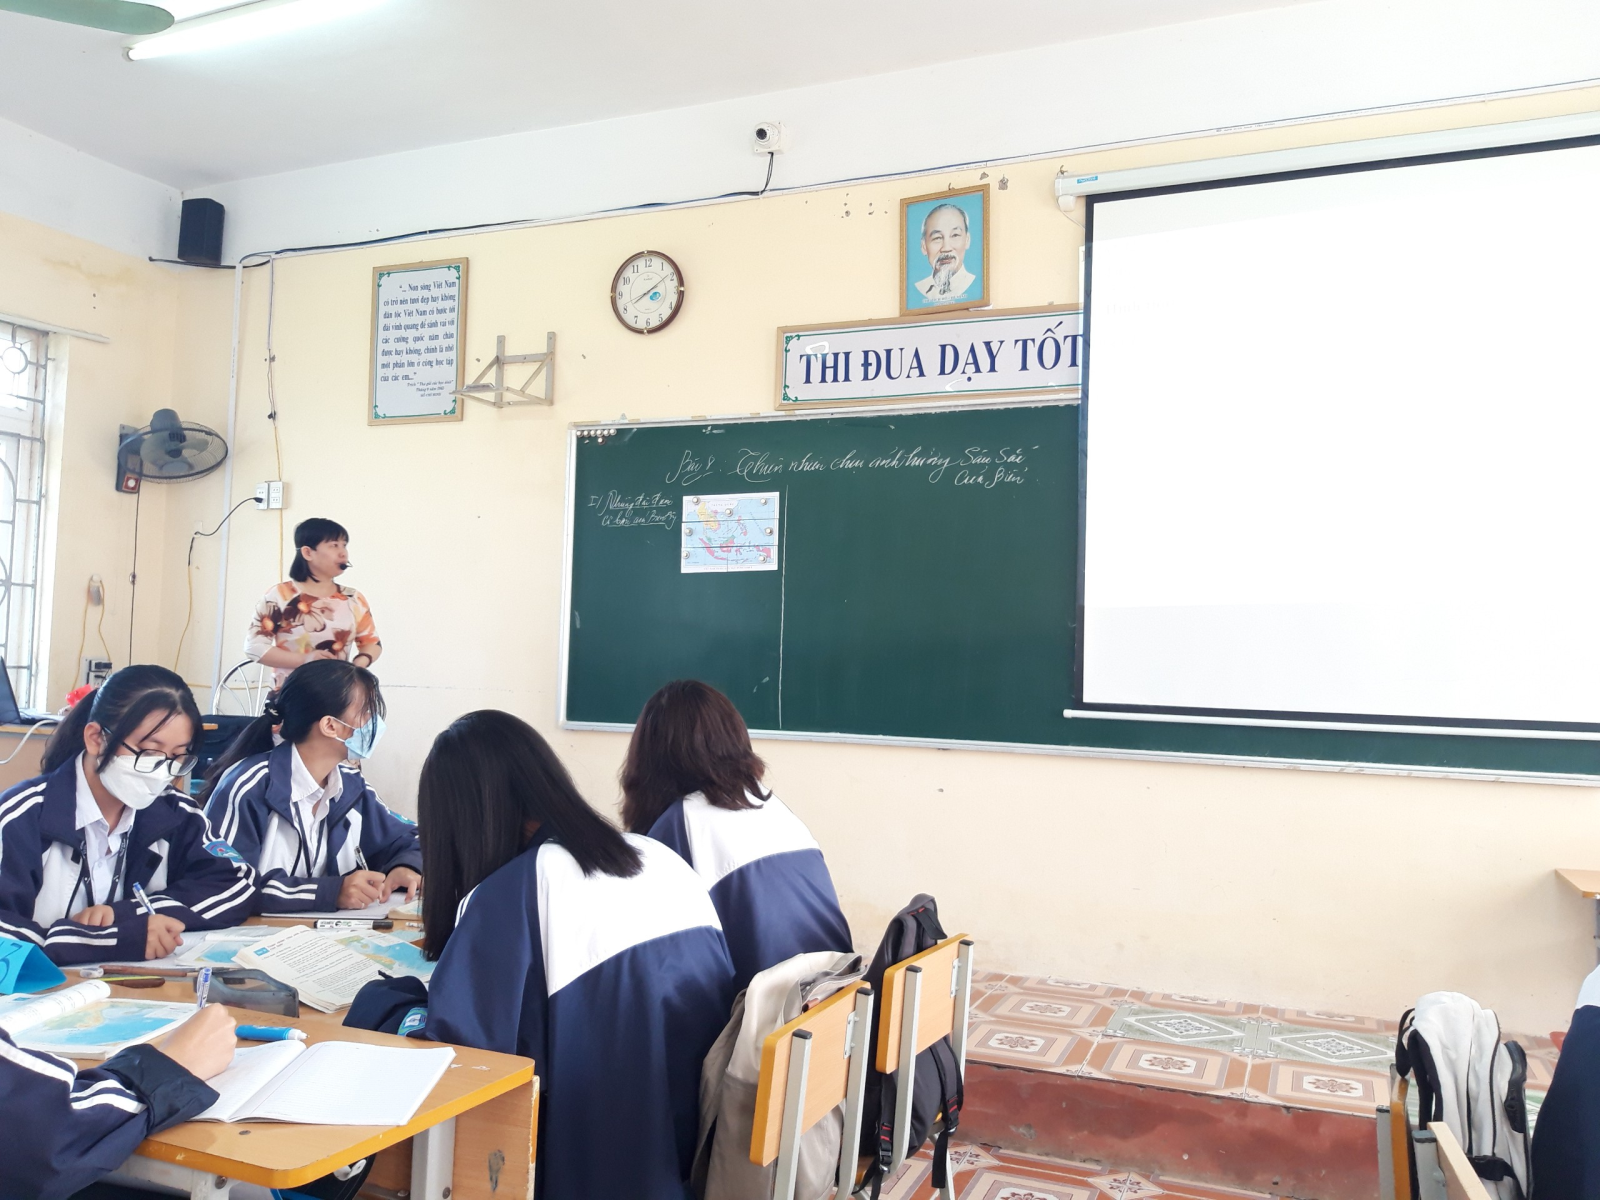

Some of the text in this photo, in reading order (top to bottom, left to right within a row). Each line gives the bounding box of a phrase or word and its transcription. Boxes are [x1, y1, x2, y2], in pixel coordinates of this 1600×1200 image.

[644, 258, 653, 268] 12
[661, 261, 665, 271] 1
[632, 264, 640, 274] 11
[622, 276, 631, 286] 10
[669, 272, 675, 282] 2
[408, 283, 419, 292] Non
[420, 282, 432, 292] sông
[433, 280, 443, 291] Việt
[444, 279, 457, 289] Nam
[383, 298, 390, 307] có
[420, 295, 430, 306] đẹp
[430, 294, 440, 304] hay
[440, 292, 456, 302] không
[618, 290, 624, 300] 9
[622, 305, 628, 315] 8
[668, 301, 673, 311] 4
[403, 308, 414, 319] Việt
[415, 308, 428, 317] Nam
[428, 307, 435, 316] có
[658, 313, 664, 323] 5
[633, 315, 639, 325] 7
[645, 317, 651, 327] 6
[403, 322, 419, 332] quang
[381, 335, 391, 344] các
[394, 347, 404, 358] hay
[423, 345, 438, 354] chính
[799, 320, 1083, 385] THI ĐUA DẠY TỐT
[421, 358, 434, 368] công
[391, 373, 400, 382] các
